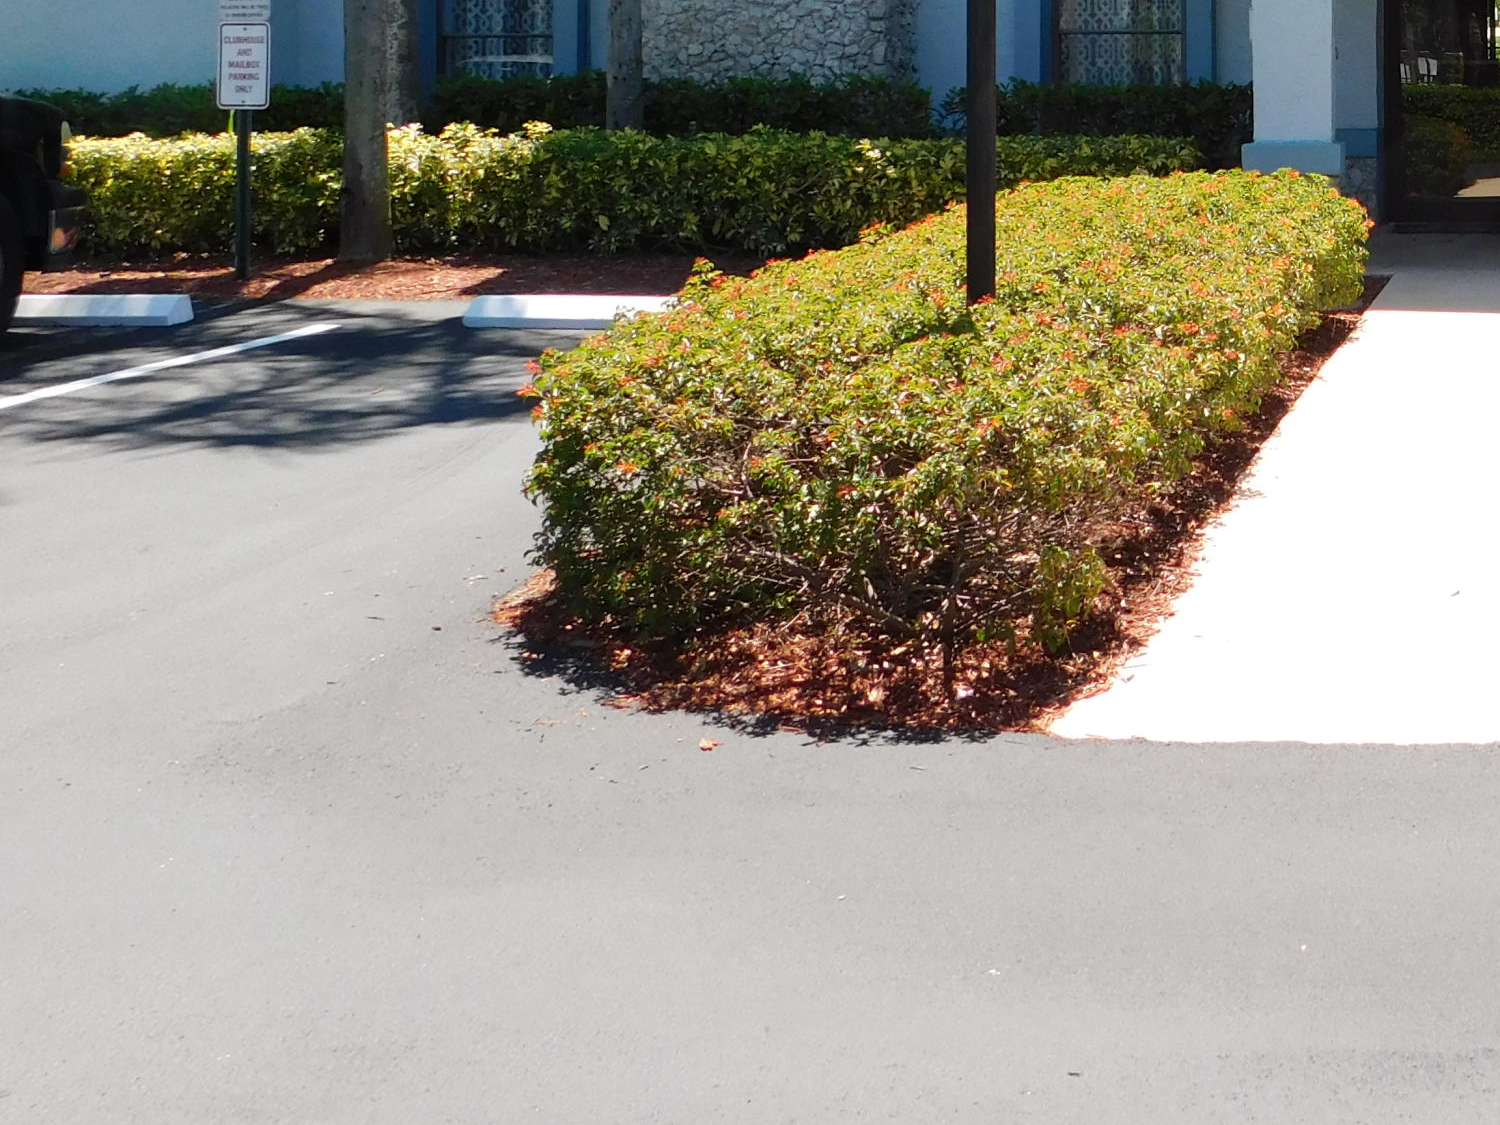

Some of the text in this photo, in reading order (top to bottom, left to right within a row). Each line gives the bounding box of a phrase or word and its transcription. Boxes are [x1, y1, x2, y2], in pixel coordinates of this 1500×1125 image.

[224, 36, 265, 44] CLUBHOUSE
[237, 48, 253, 56] AND
[228, 61, 260, 69] MAILBOX
[228, 73, 260, 81] PARKING
[235, 85, 253, 93] ONLY
